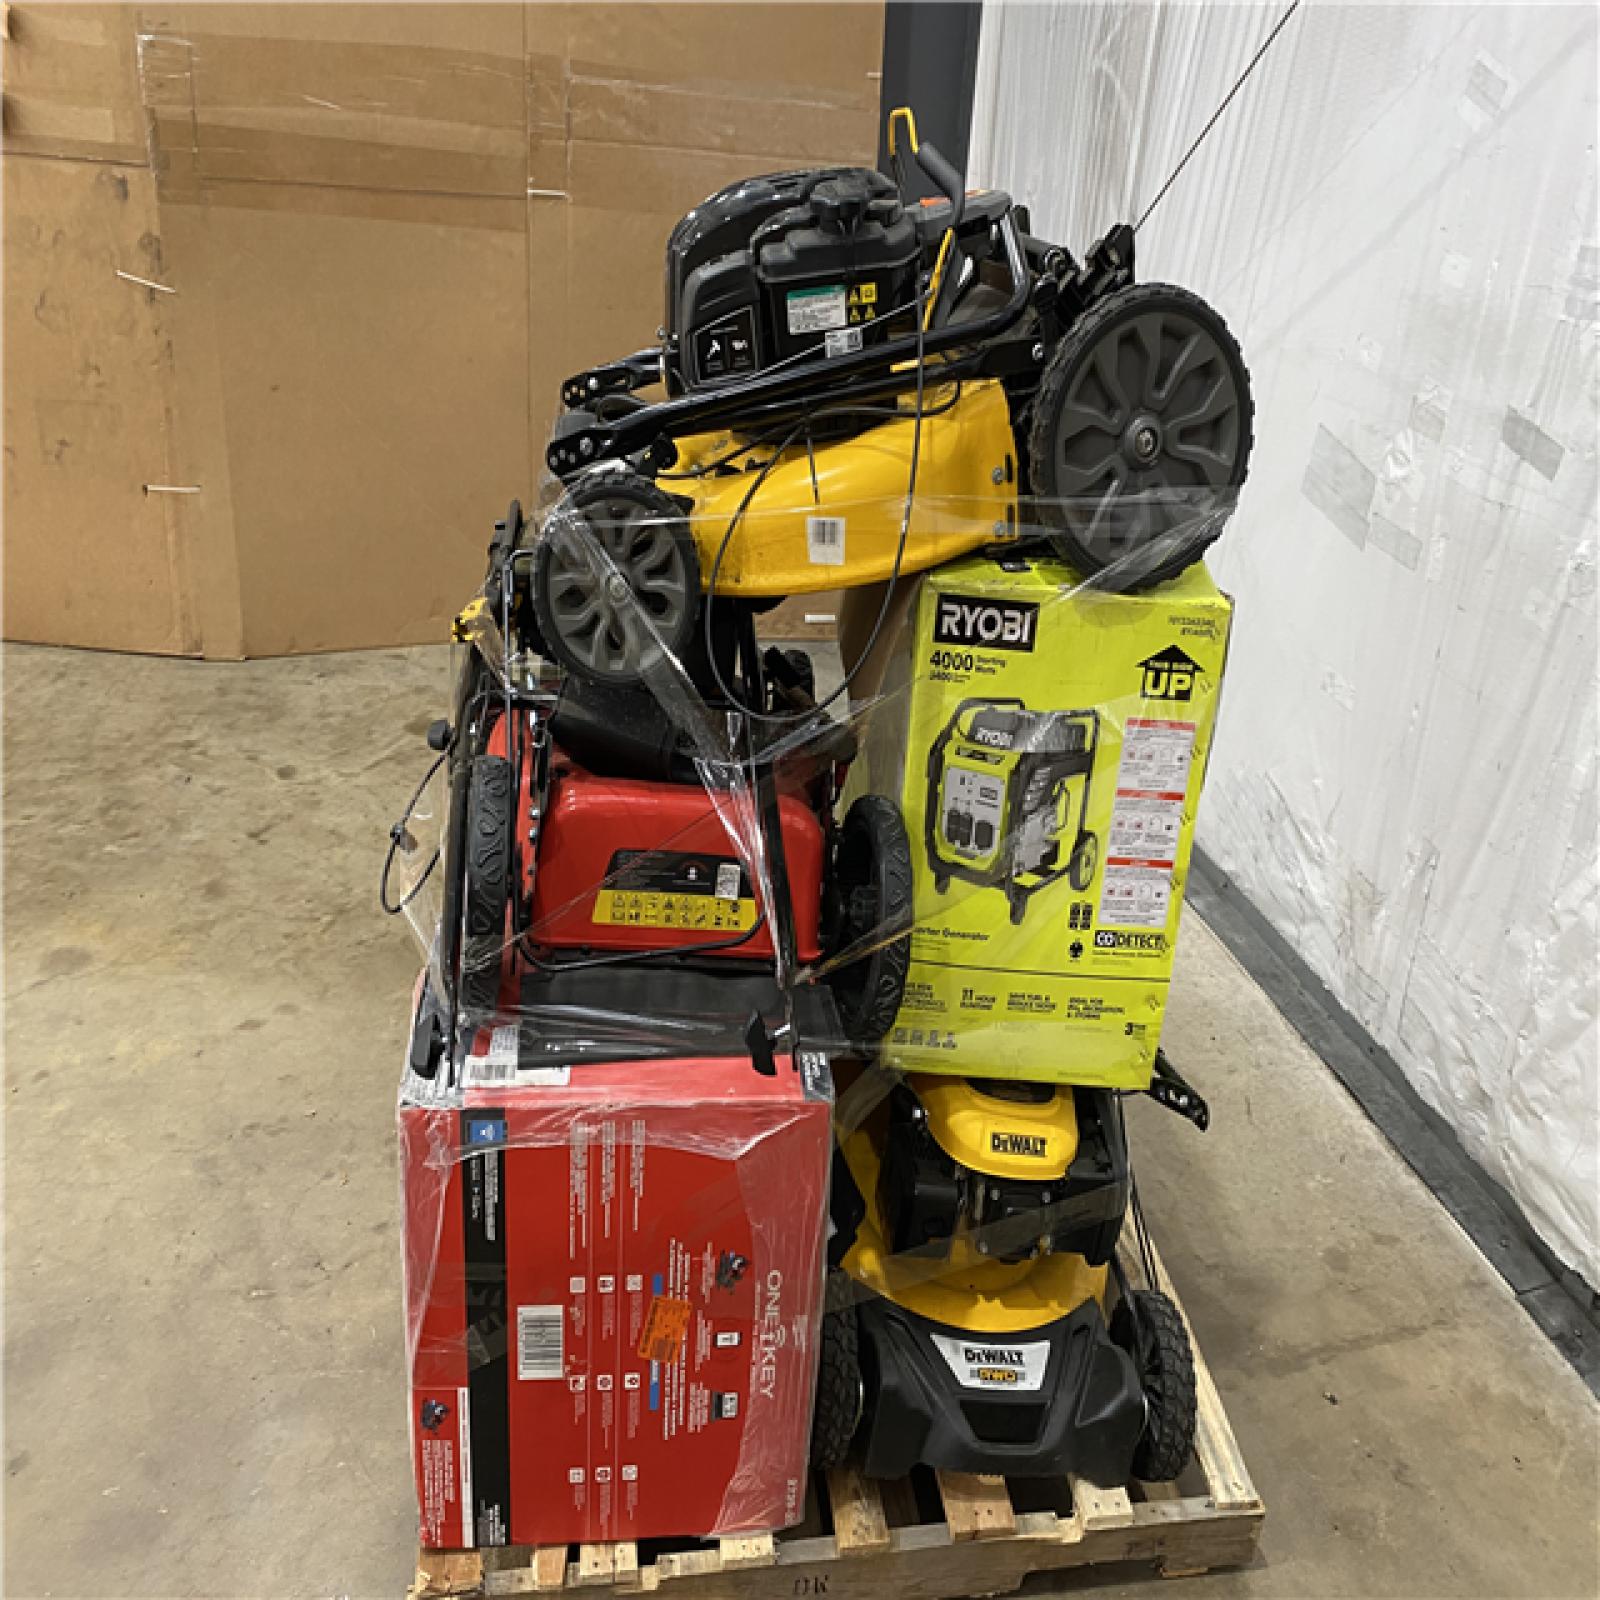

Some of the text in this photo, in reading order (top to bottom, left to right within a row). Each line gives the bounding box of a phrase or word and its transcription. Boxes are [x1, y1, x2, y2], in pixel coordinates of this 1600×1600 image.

[940, 603, 1032, 643] RYOBI
[930, 651, 973, 671] 4000
[1144, 671, 1192, 697] UP
[759, 1270, 782, 1400] ONE KEY
